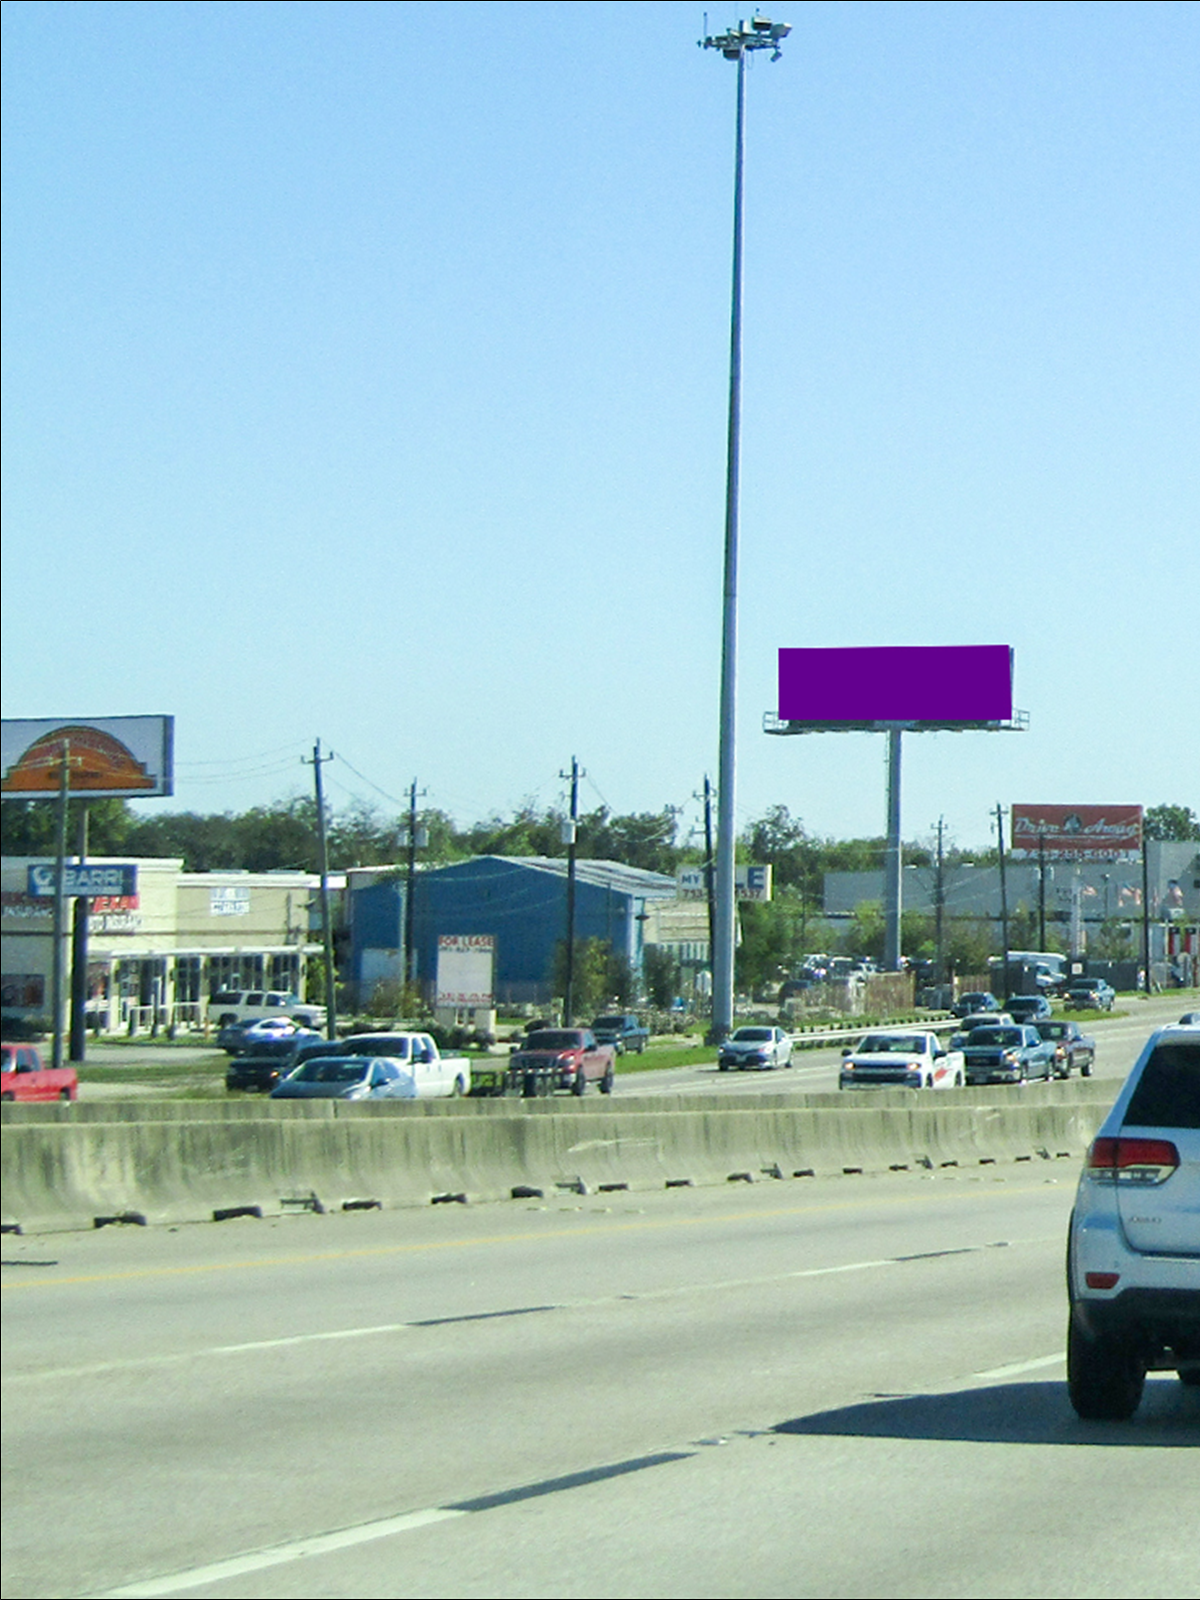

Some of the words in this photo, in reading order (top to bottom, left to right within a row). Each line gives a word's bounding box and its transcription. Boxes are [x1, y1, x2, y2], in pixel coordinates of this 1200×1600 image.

[1014, 817, 1060, 833] Drive
[438, 935, 458, 947] FOR
[462, 935, 494, 947] LEASE
